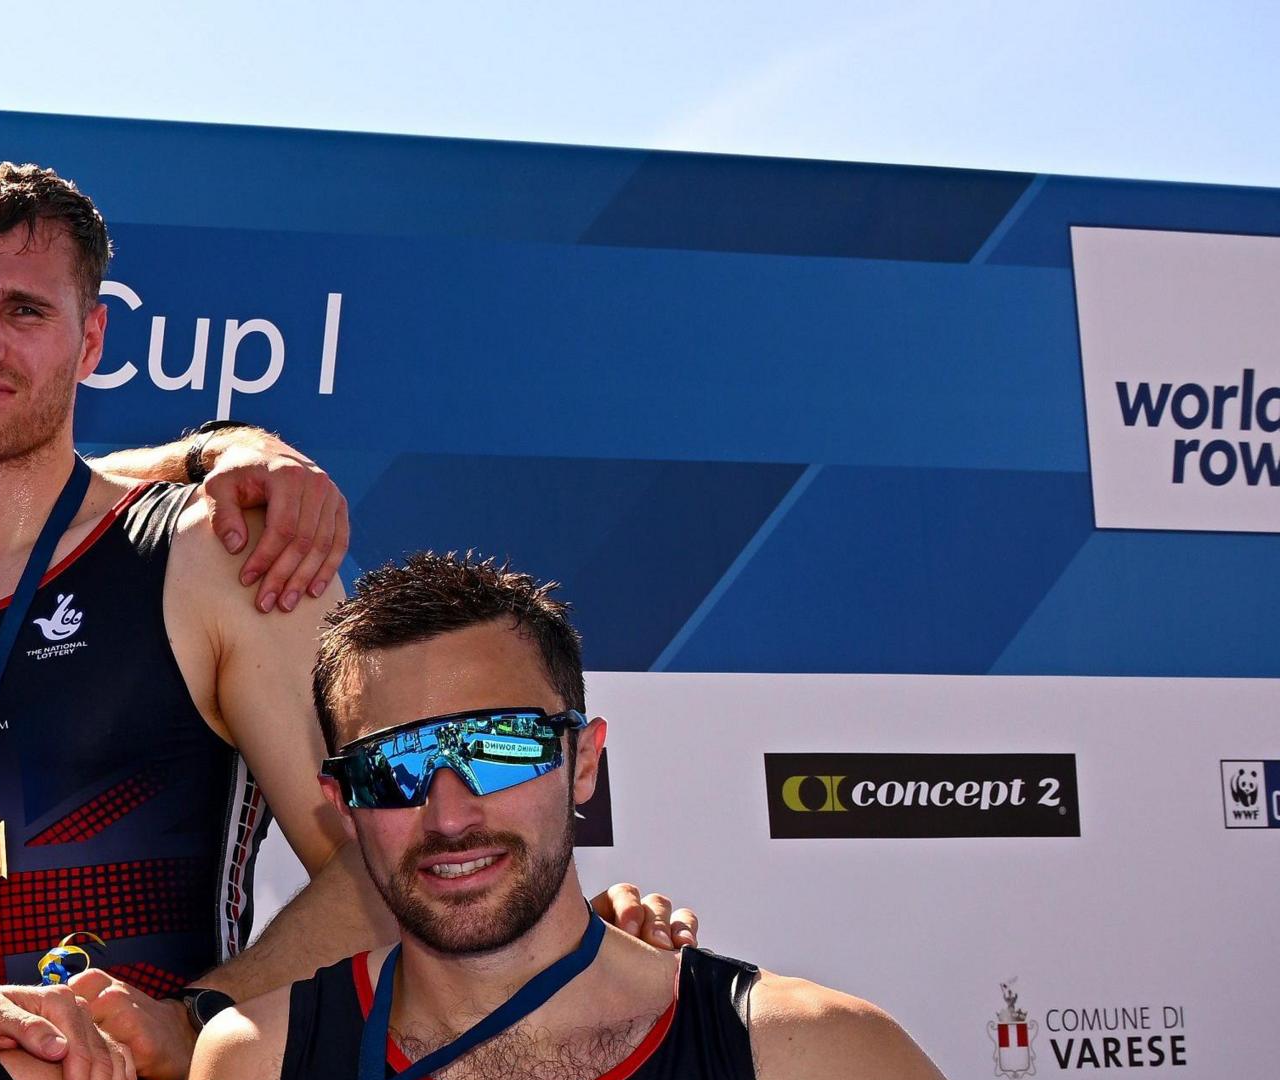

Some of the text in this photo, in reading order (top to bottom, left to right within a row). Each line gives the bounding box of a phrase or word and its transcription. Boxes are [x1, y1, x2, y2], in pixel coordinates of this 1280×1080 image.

[82, 280, 286, 421] Cup
[1172, 439, 1280, 487] row
[26, 641, 88, 656] THE NATIONAL
[36, 648, 75, 660] LOTTERY
[851, 777, 1061, 810] concept 2
[1232, 810, 1259, 820] WWF
[1045, 1006, 1184, 1032] COMUNE DI
[1050, 1035, 1187, 1069] VARESE
